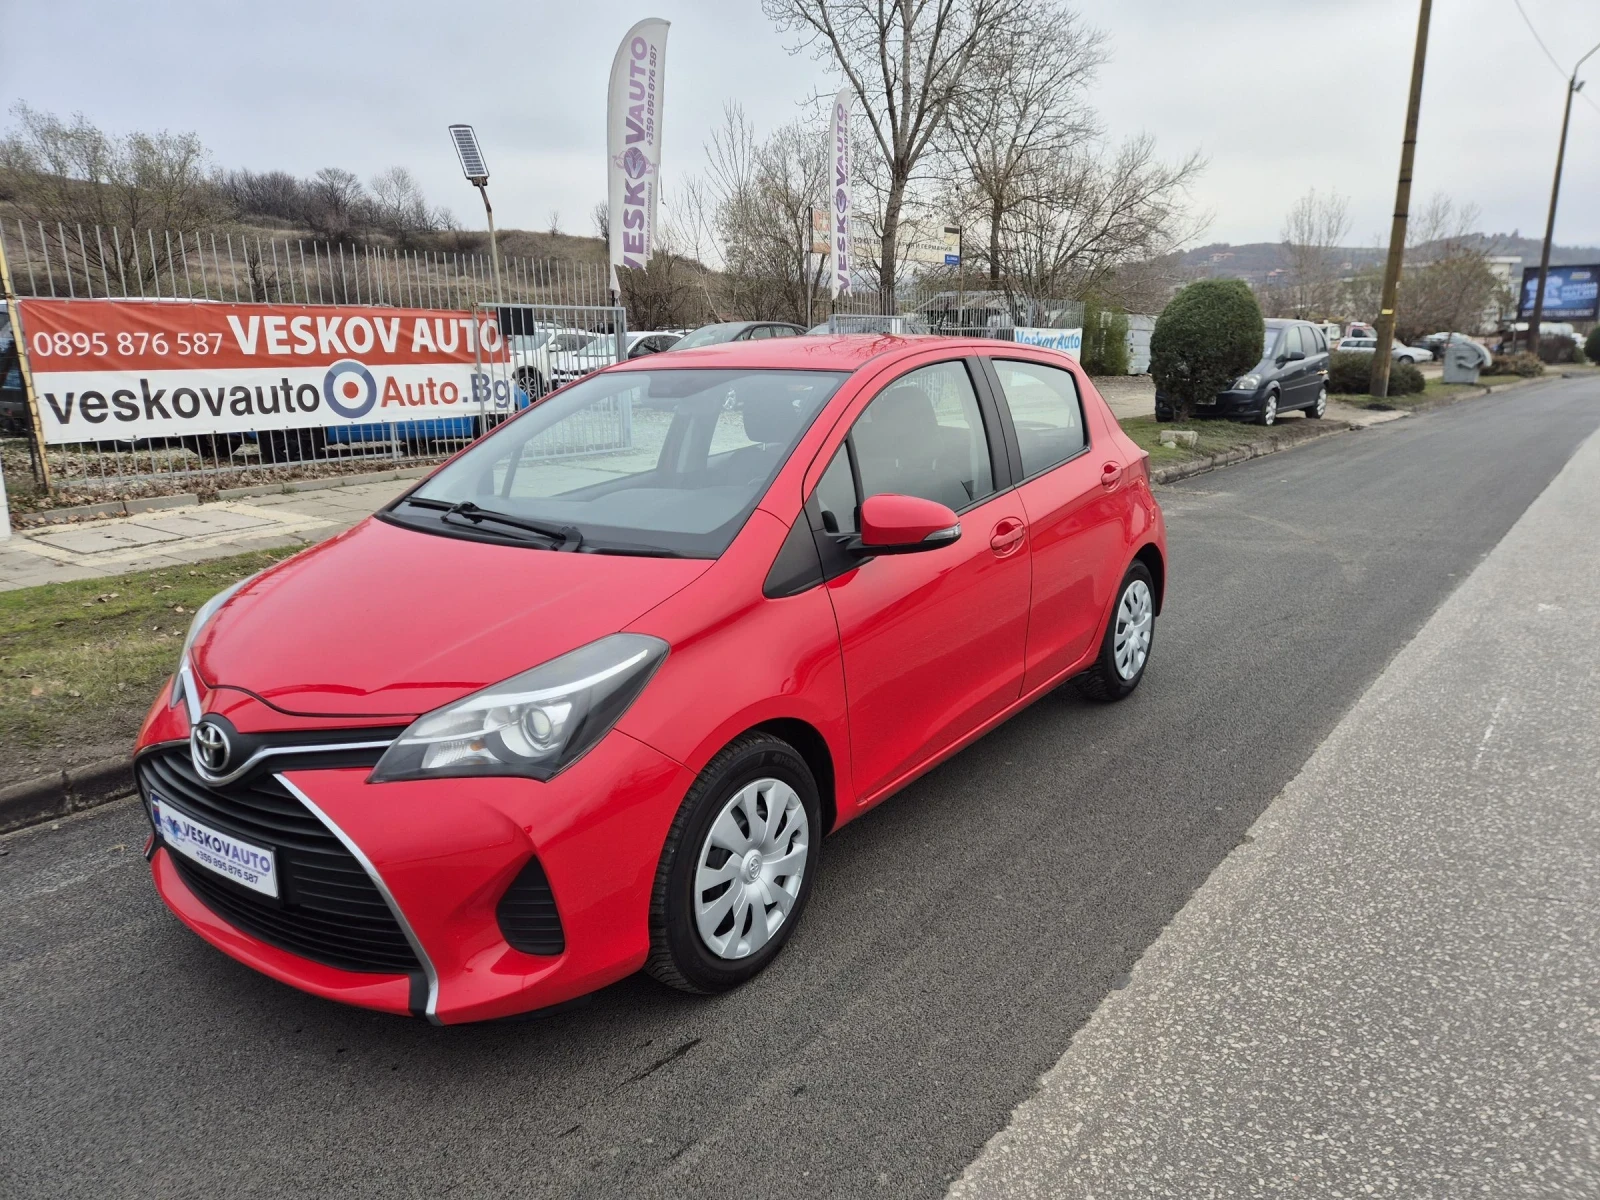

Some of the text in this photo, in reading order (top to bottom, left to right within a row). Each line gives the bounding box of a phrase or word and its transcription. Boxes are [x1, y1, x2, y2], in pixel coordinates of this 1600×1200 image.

[646, 44, 658, 146] +359 895 876 587
[32, 314, 503, 357] 0895 876 587 VESKOV AUTO
[1056, 333, 1080, 349] Auto
[44, 378, 320, 426] veskovauto
[182, 821, 271, 873] VESKOVAUTO
[196, 850, 259, 884] +359 895 876 587
